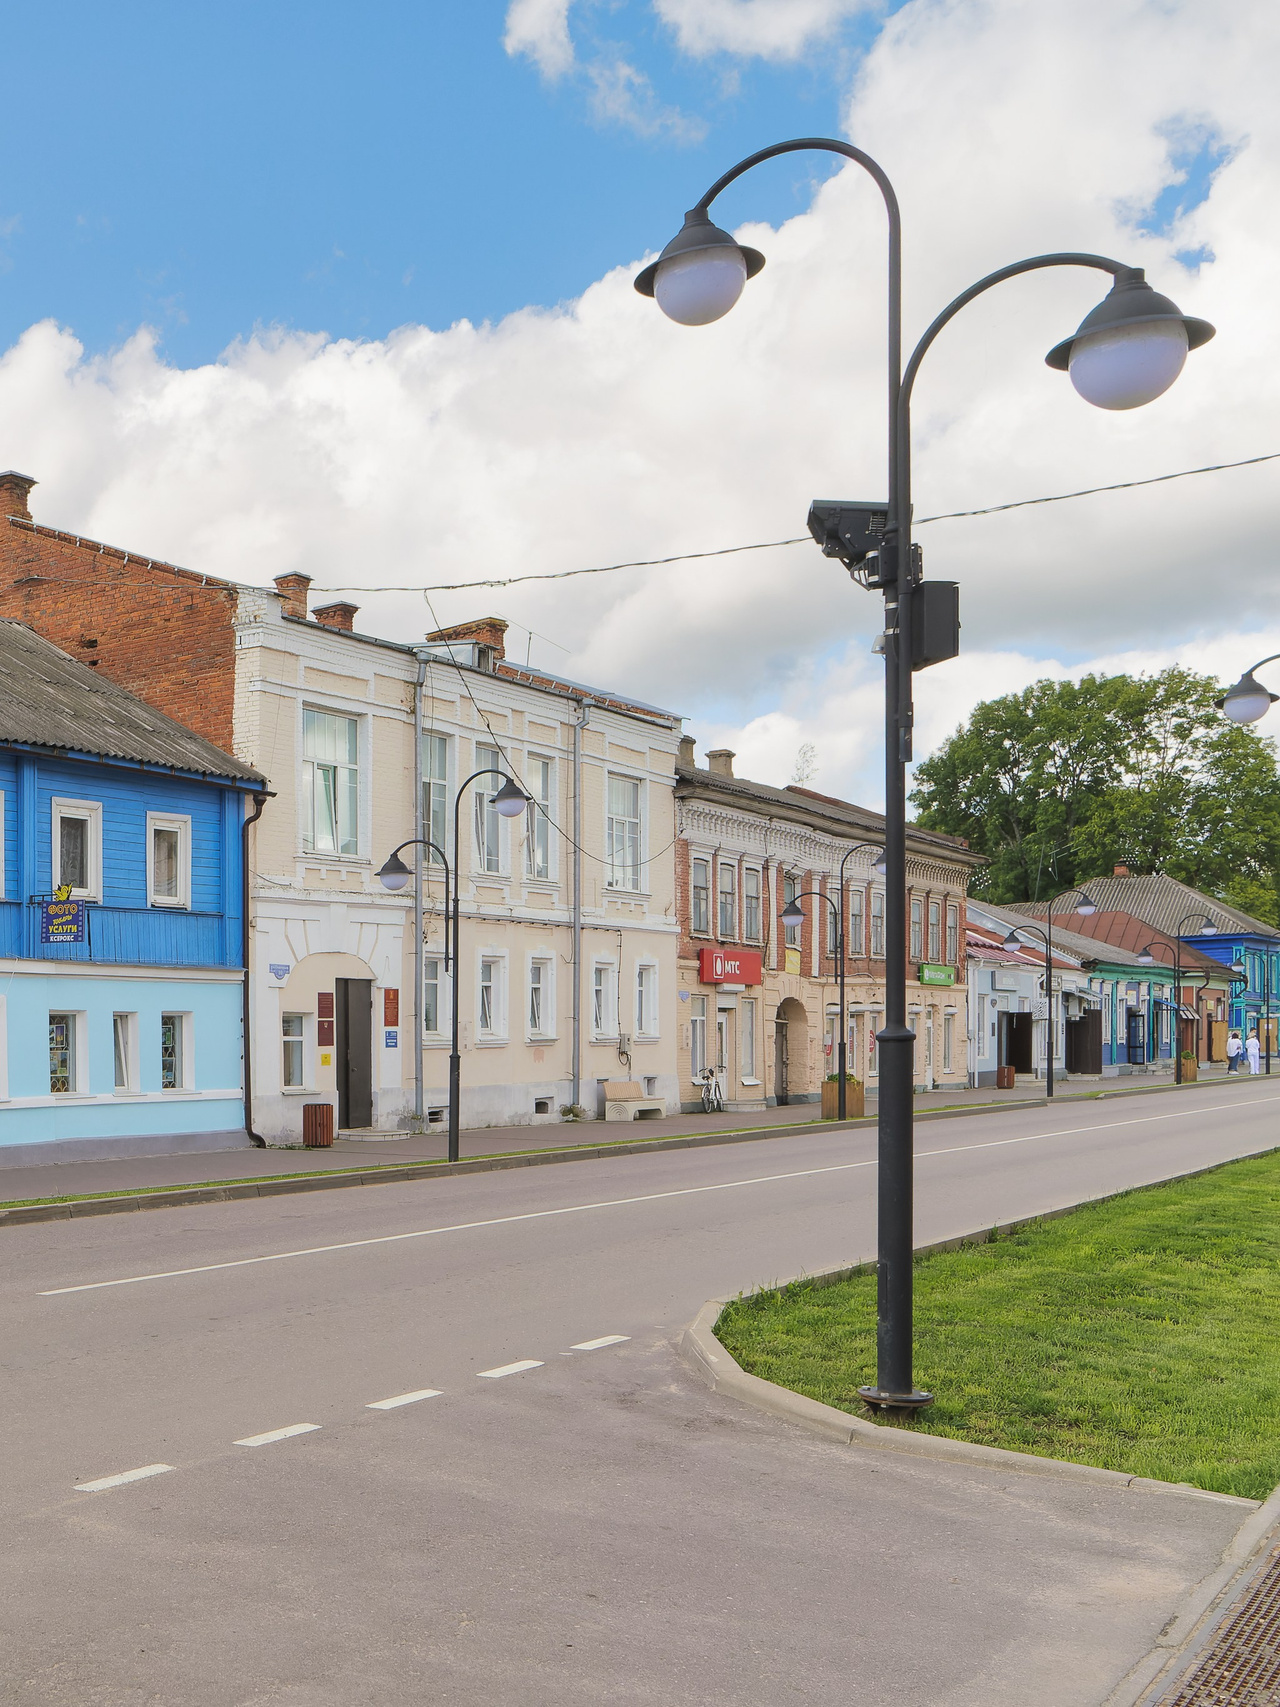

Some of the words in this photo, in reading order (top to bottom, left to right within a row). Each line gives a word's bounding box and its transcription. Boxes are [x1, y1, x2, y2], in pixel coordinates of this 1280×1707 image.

[48, 904, 78, 914] ФОТО
[49, 925, 77, 933] УСЛУГИ
[724, 960, 740, 974] МТС
